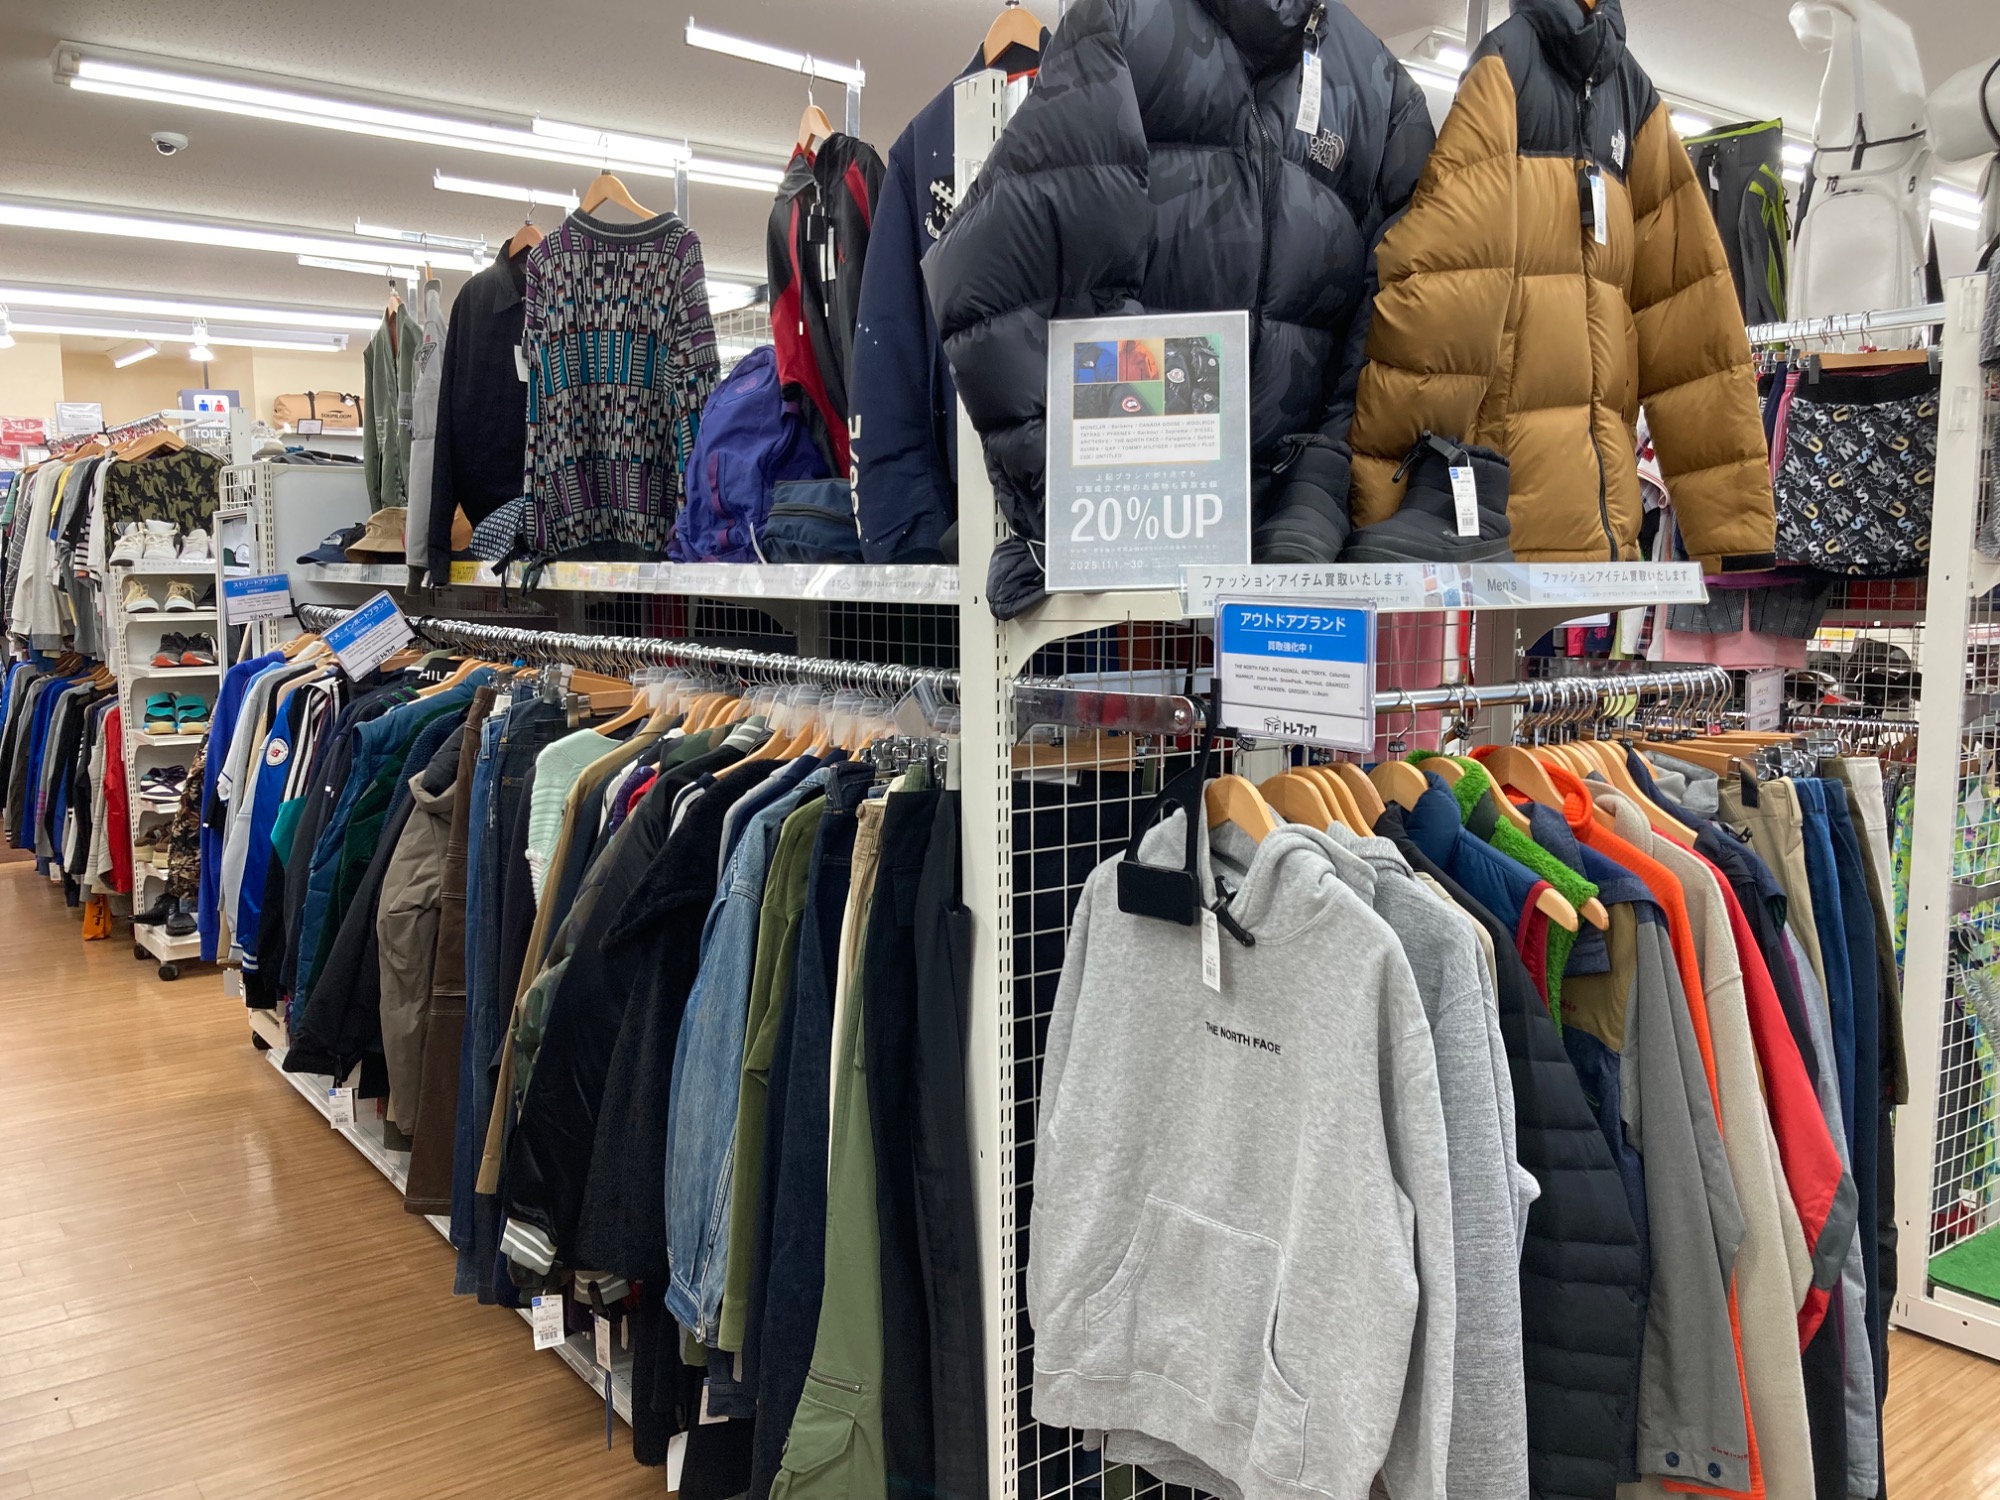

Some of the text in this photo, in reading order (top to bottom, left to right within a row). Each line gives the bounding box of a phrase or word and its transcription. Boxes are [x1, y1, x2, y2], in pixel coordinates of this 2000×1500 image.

[193, 428, 229, 440] TOILE
[1070, 493, 1224, 543] 20%UP
[1487, 578, 1517, 592] Men's
[1239, 611, 1347, 633] アウトドアブランド
[1205, 1021, 1282, 1056] THE NORTH FACE
